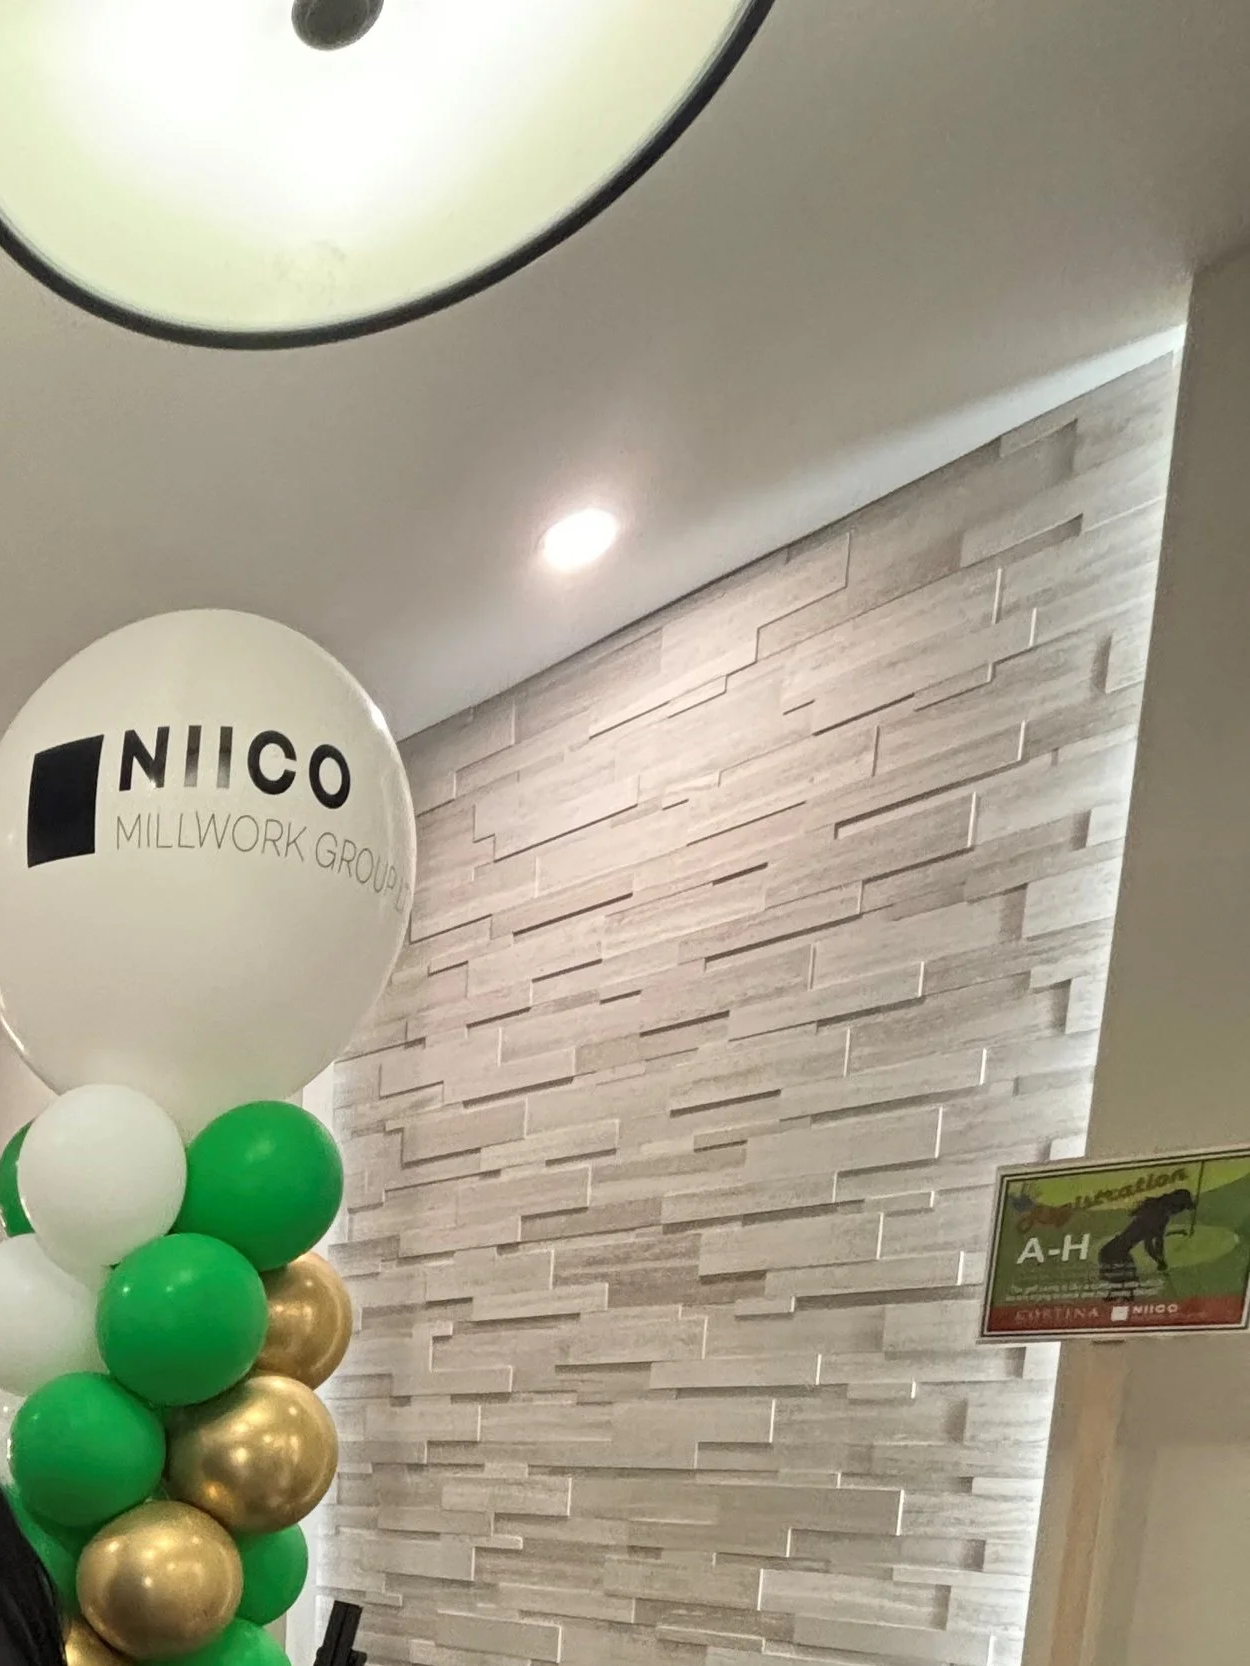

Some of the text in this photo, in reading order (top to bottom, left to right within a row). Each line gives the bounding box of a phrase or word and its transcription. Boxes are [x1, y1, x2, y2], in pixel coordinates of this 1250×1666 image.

[118, 725, 351, 809] NIICO
[116, 811, 307, 863] MILLWORK
[315, 832, 398, 896] GROUP
[1016, 1233, 1090, 1265] A-H
